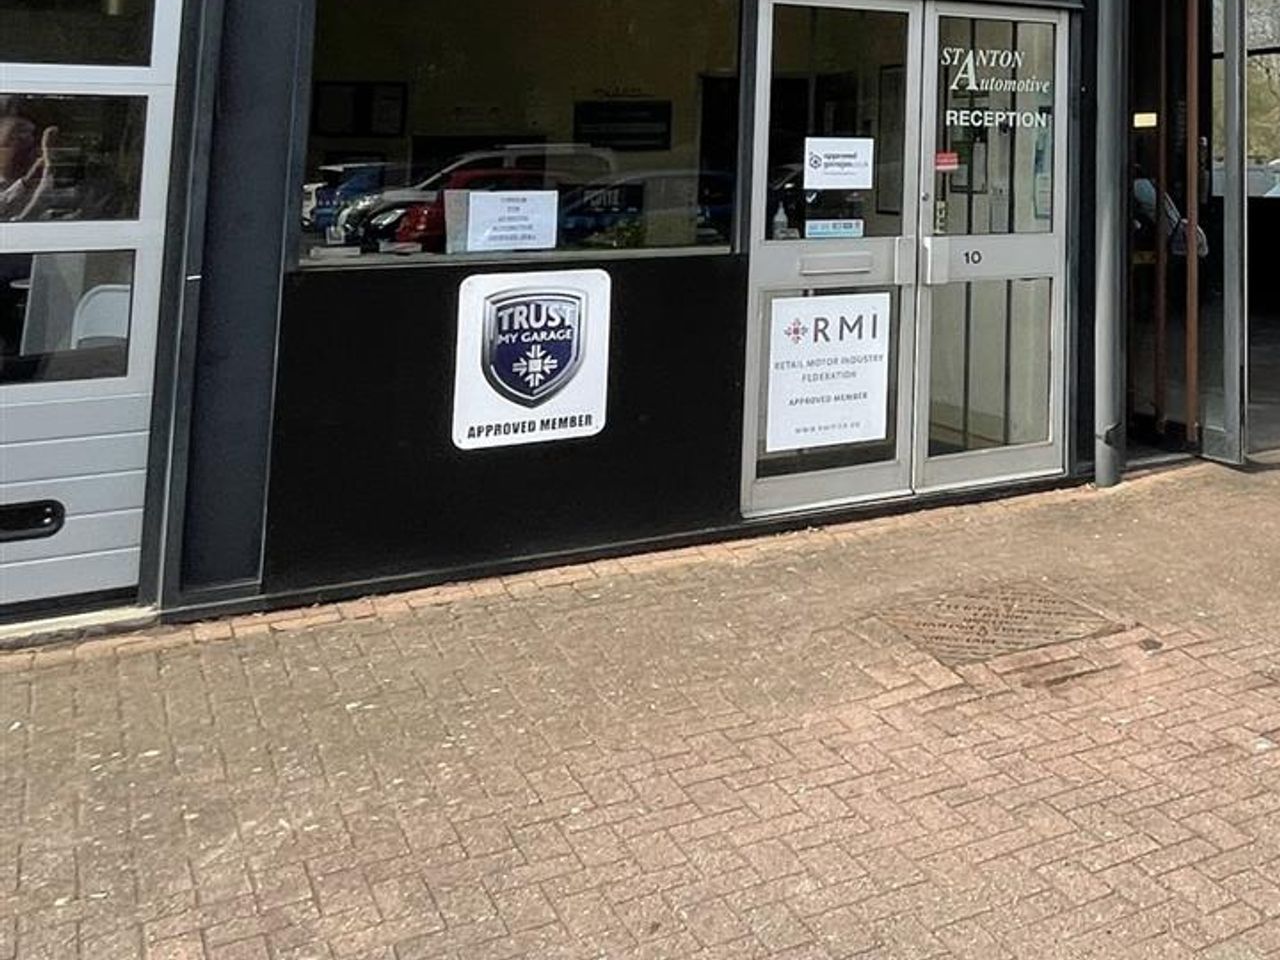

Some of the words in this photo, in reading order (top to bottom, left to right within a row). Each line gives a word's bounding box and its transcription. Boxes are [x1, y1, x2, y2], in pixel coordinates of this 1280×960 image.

[941, 46, 1025, 90] STANTON
[945, 110, 1047, 128] RECEPTION
[964, 250, 982, 265] 10
[498, 303, 574, 330] TRUST
[498, 331, 518, 344] MY
[521, 328, 573, 343] GARAGE
[814, 313, 877, 343] RMI
[788, 394, 832, 406] APPROVED
[834, 392, 868, 402] MEMBER
[467, 419, 537, 439] APPROVED
[540, 413, 593, 433] MEMBER
